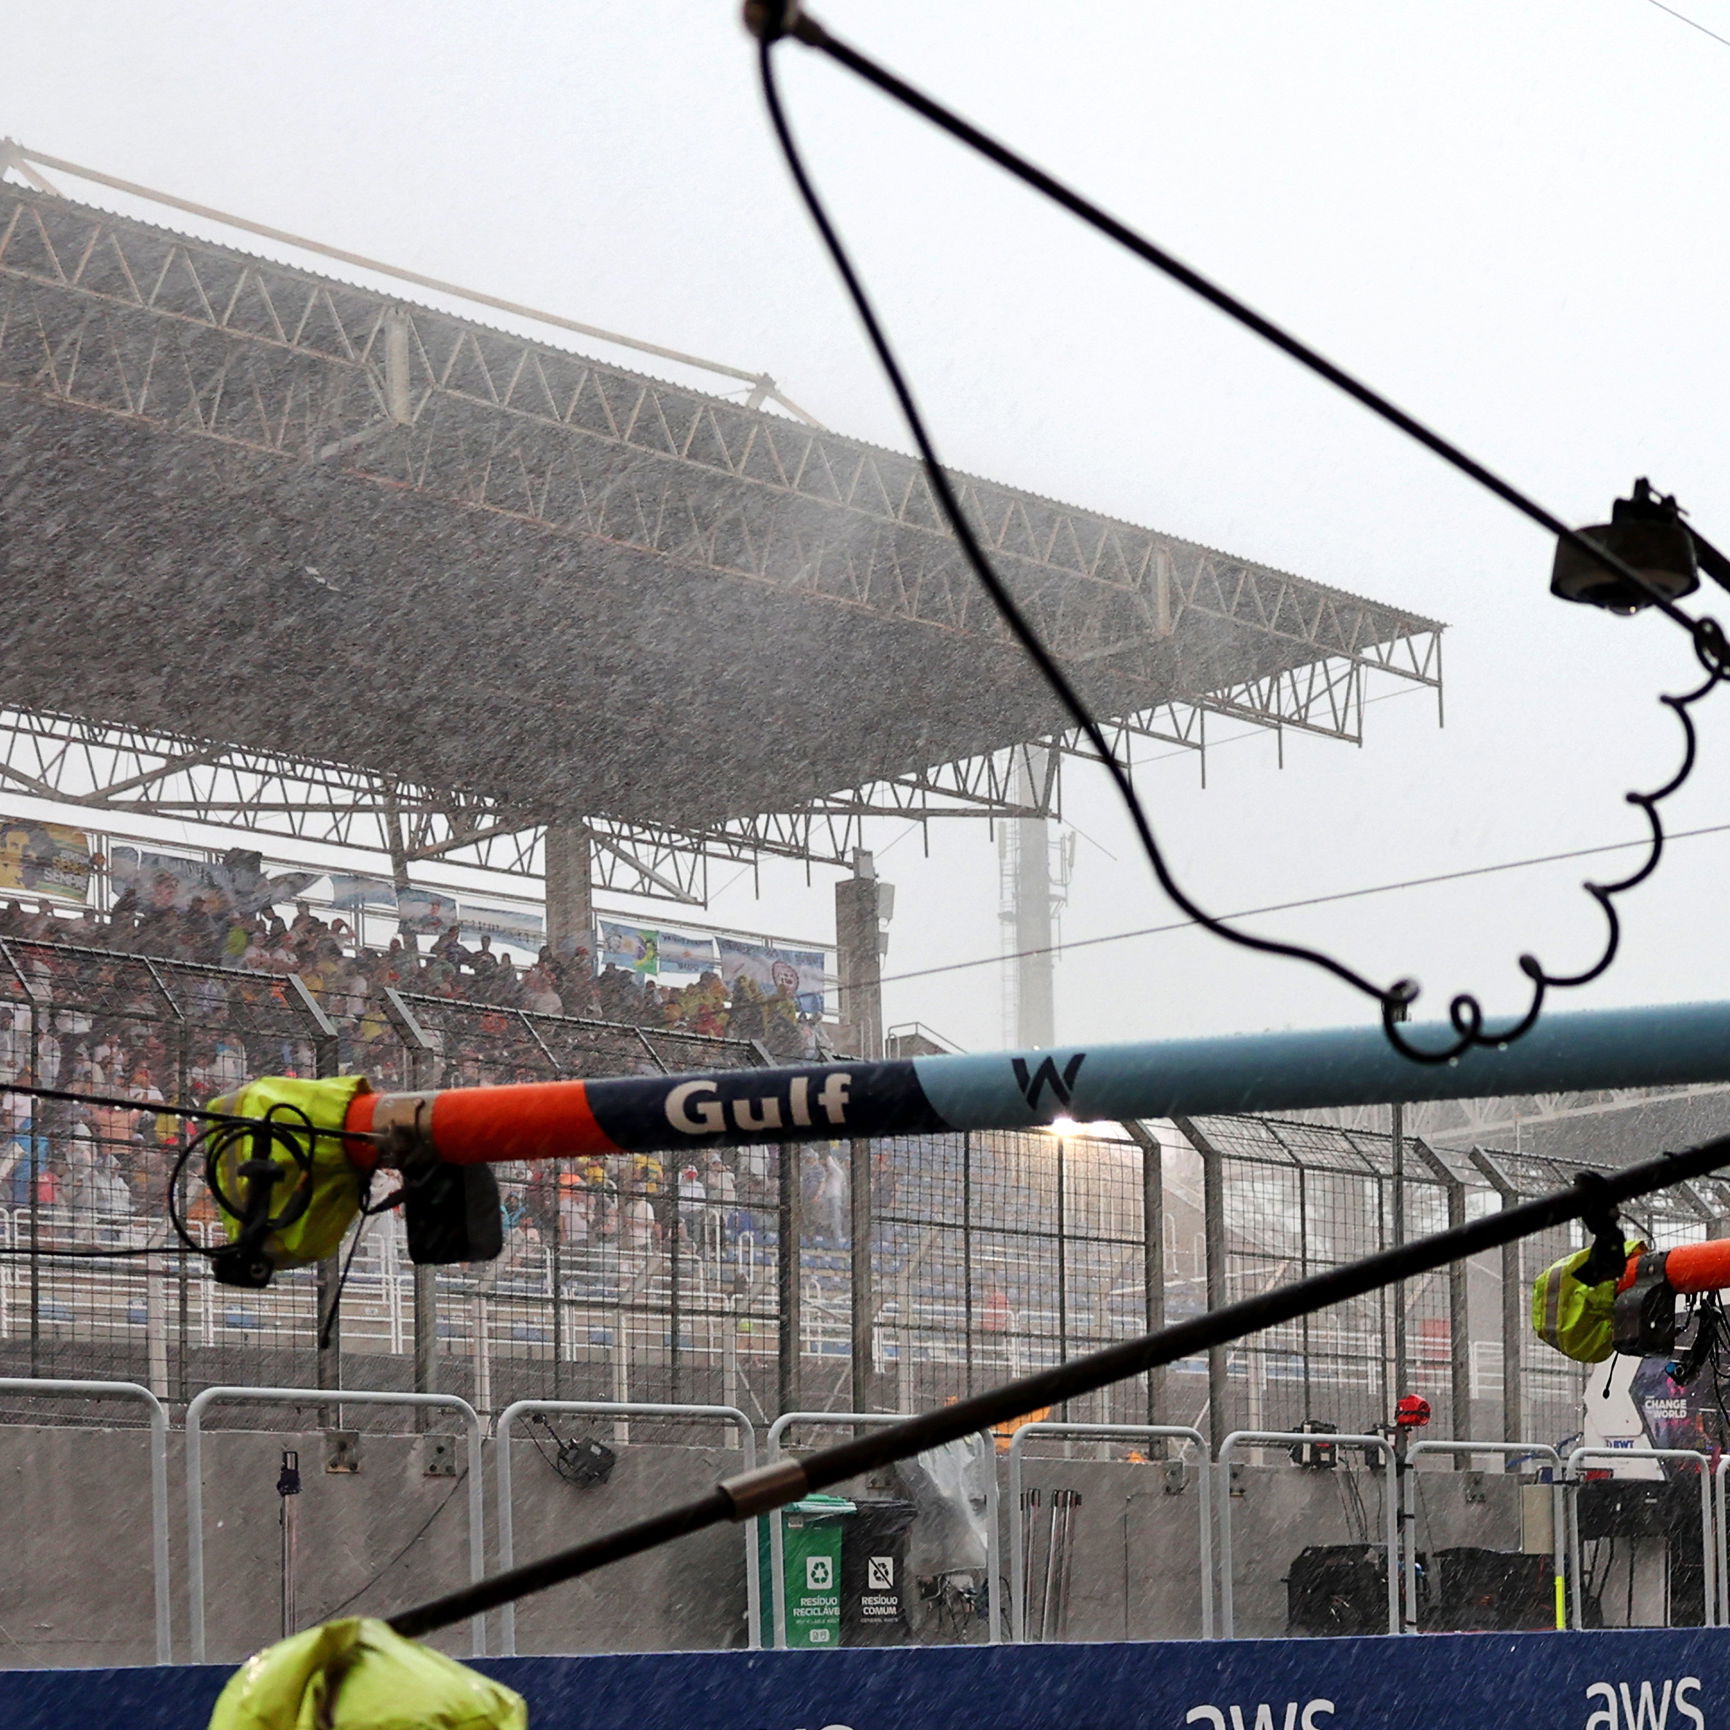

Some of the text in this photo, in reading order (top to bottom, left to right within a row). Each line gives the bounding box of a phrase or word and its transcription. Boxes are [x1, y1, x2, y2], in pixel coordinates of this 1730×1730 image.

[665, 1072, 852, 1135] Gulf
[1645, 1399, 1687, 1409] CHANGE
[1654, 1410, 1687, 1418] WORLD
[800, 1595, 838, 1606] RESÍDUO
[861, 1594, 898, 1605] RESÍDUO
[863, 1606, 897, 1615] COMUM
